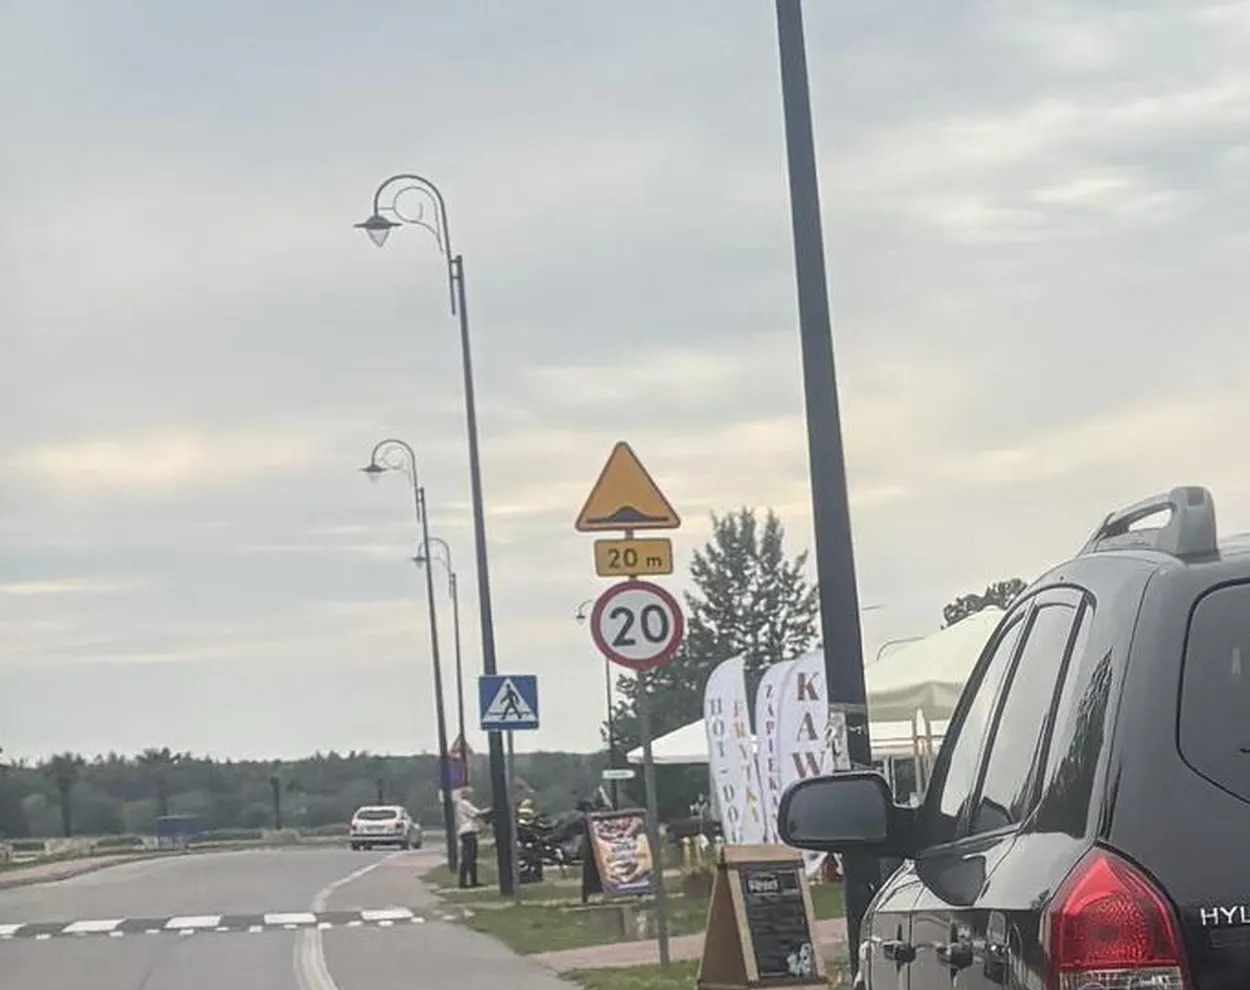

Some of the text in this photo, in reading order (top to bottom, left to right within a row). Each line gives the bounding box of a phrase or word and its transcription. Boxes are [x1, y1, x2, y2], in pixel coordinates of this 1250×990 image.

[607, 548, 662, 569] 20 m
[609, 604, 669, 646] 20
[792, 671, 827, 778] KAW
